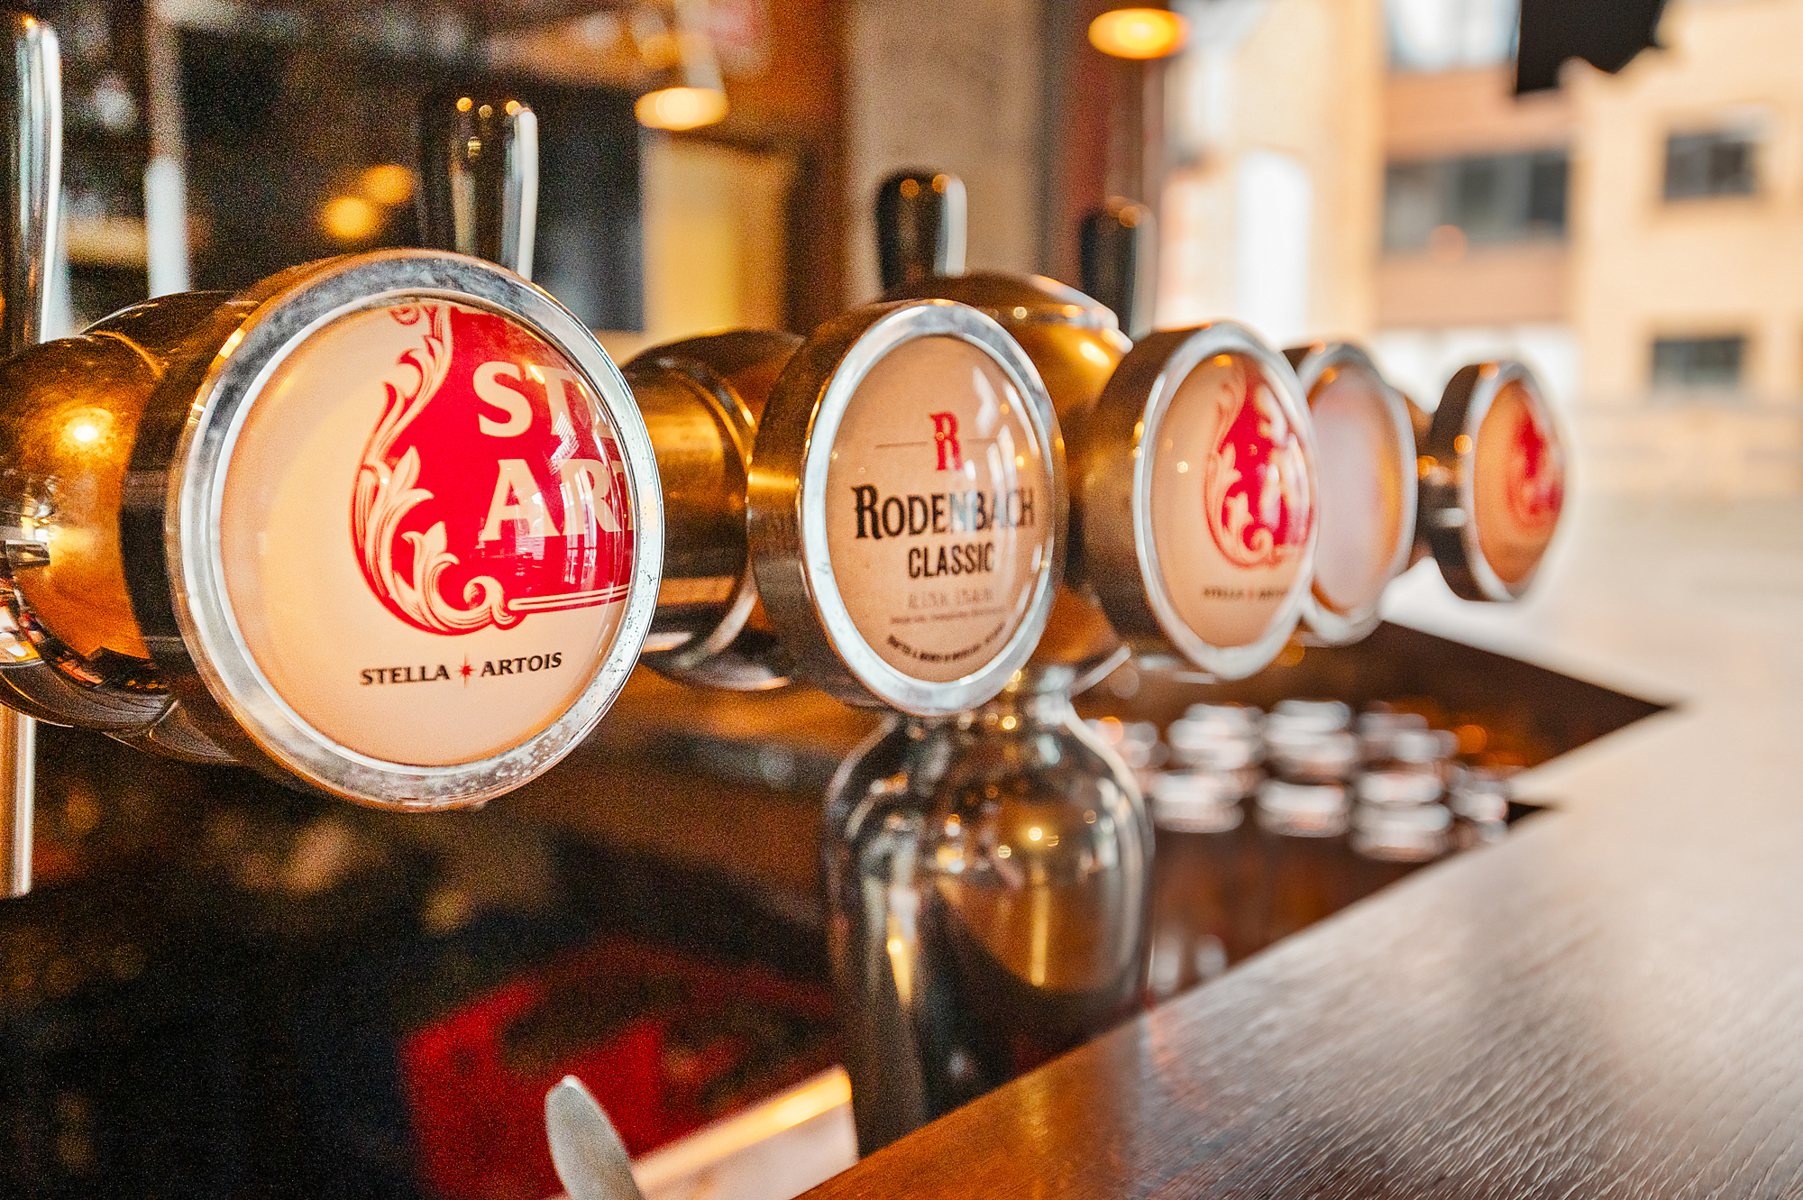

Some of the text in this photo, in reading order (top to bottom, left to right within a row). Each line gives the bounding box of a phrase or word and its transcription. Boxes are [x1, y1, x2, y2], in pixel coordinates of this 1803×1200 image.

[929, 411, 965, 472] R
[851, 483, 1036, 540] RODENBACH
[907, 541, 996, 579] CLASSIC
[359, 651, 563, 686] STELLA ARTOIS
